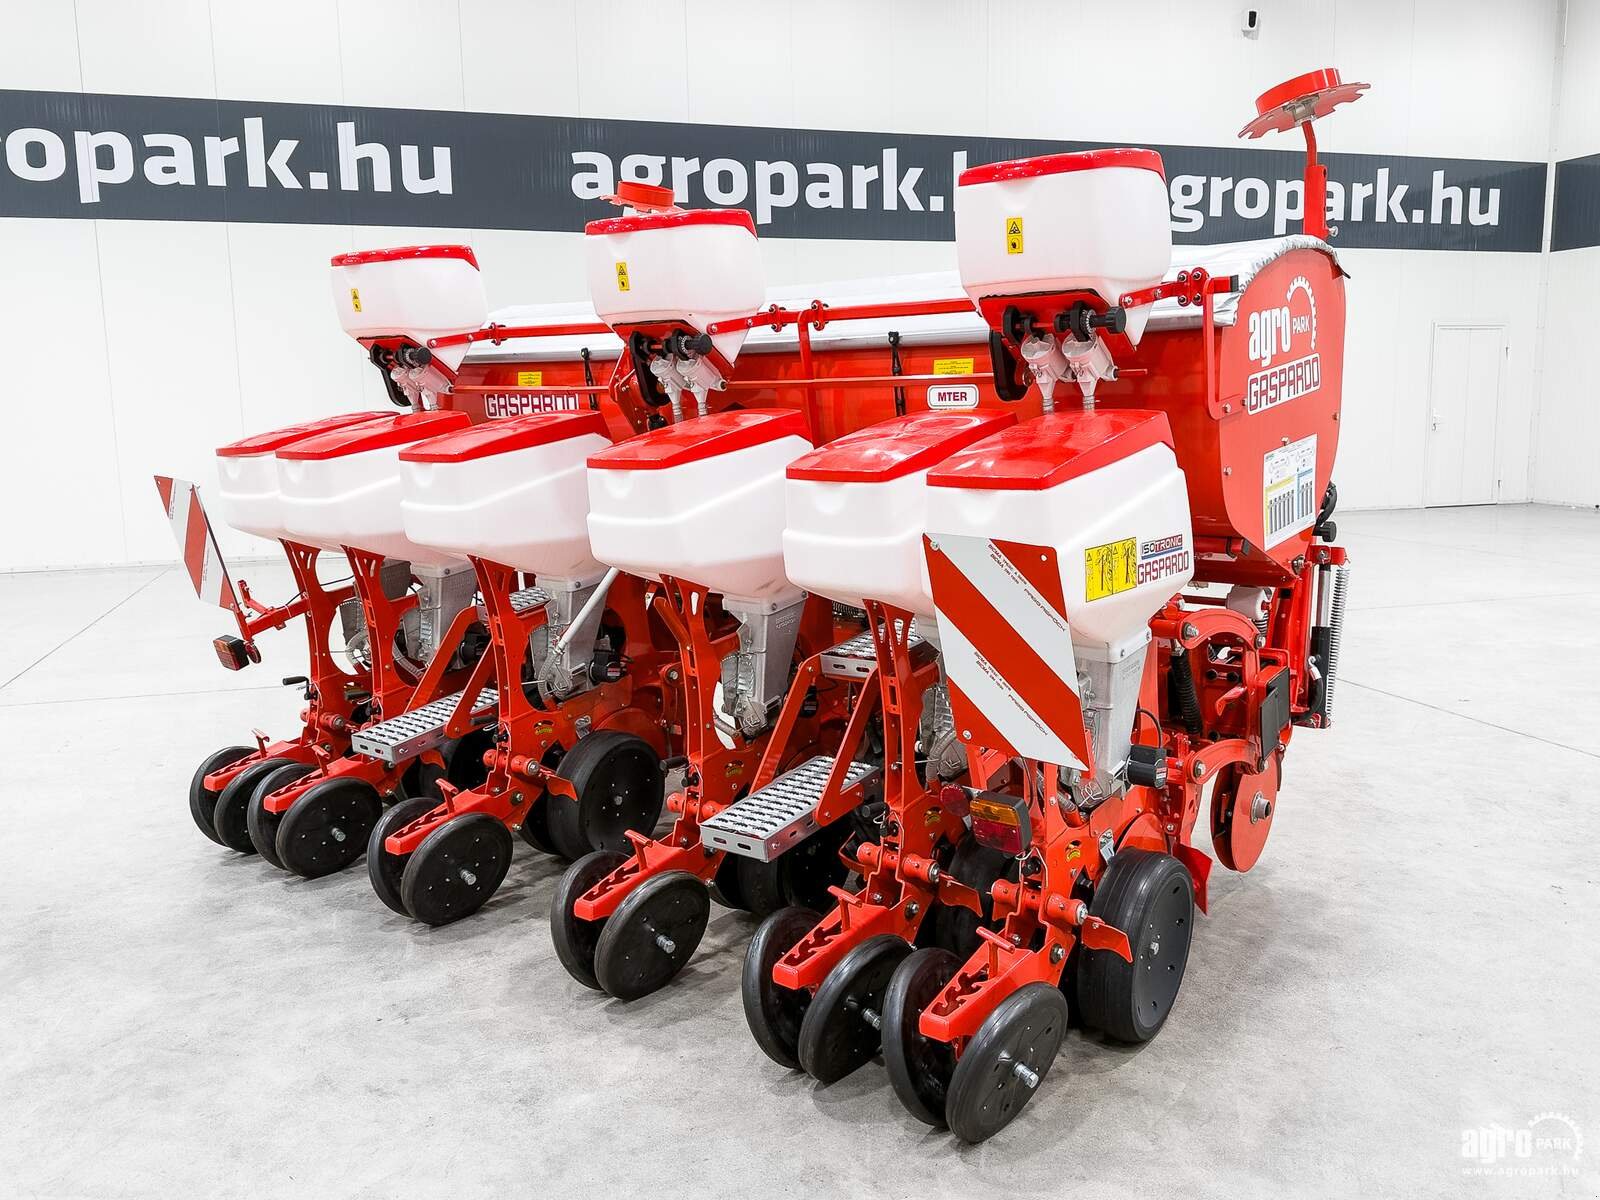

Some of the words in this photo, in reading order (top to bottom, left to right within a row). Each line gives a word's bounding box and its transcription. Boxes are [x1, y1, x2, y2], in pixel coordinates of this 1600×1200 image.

[0, 117, 453, 203] opark.hu
[571, 147, 967, 224] agropark.
[1170, 167, 1500, 235] gropark.hu
[1249, 306, 1291, 367] agro
[1293, 316, 1310, 334] PARK
[937, 391, 968, 402] MTER
[1249, 357, 1319, 411] GASPARDO
[1137, 550, 1189, 585] GASPARDO
